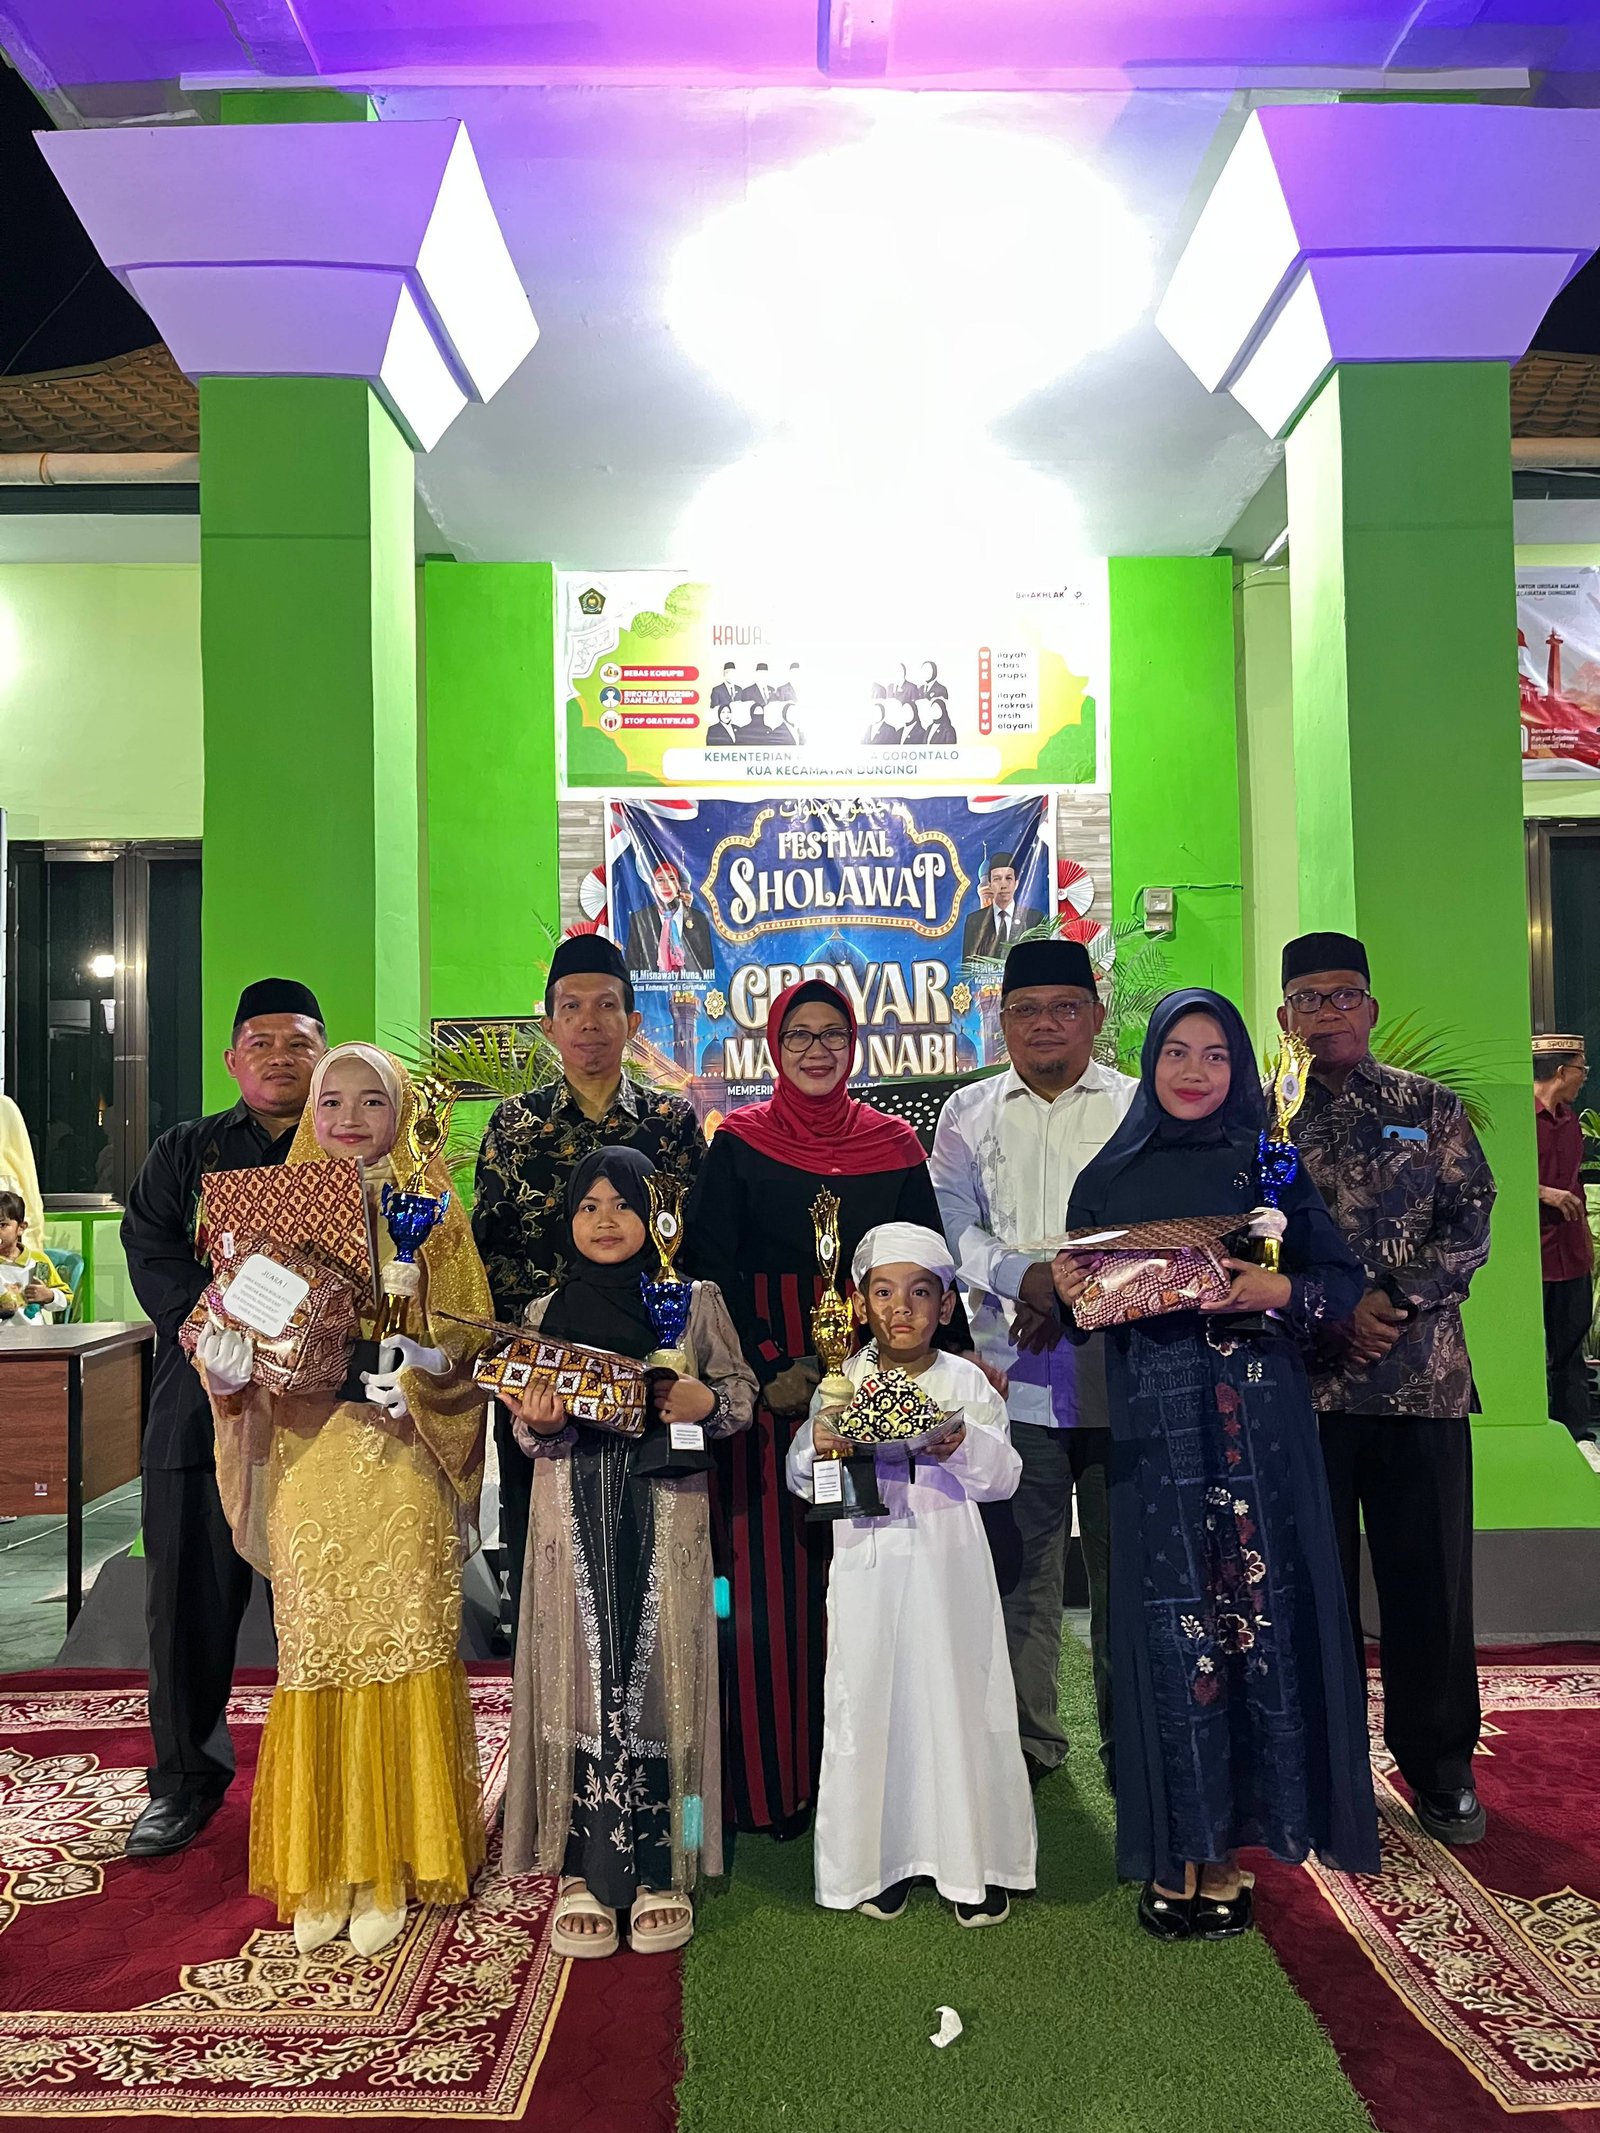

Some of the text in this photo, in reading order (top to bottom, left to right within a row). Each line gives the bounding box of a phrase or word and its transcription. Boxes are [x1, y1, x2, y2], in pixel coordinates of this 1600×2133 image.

[713, 625, 768, 646] KAWA
[624, 717, 695, 725] STOP GRATIFIKASI
[704, 752, 792, 762] KEMENTERIAN
[882, 750, 960, 761] GORONTALO
[746, 766, 772, 775] KUA
[778, 830, 895, 860] FESTIVAL
[729, 852, 946, 925] SHOLAWAT
[703, 968, 716, 980] MH
[867, 1033, 957, 1077] NABI
